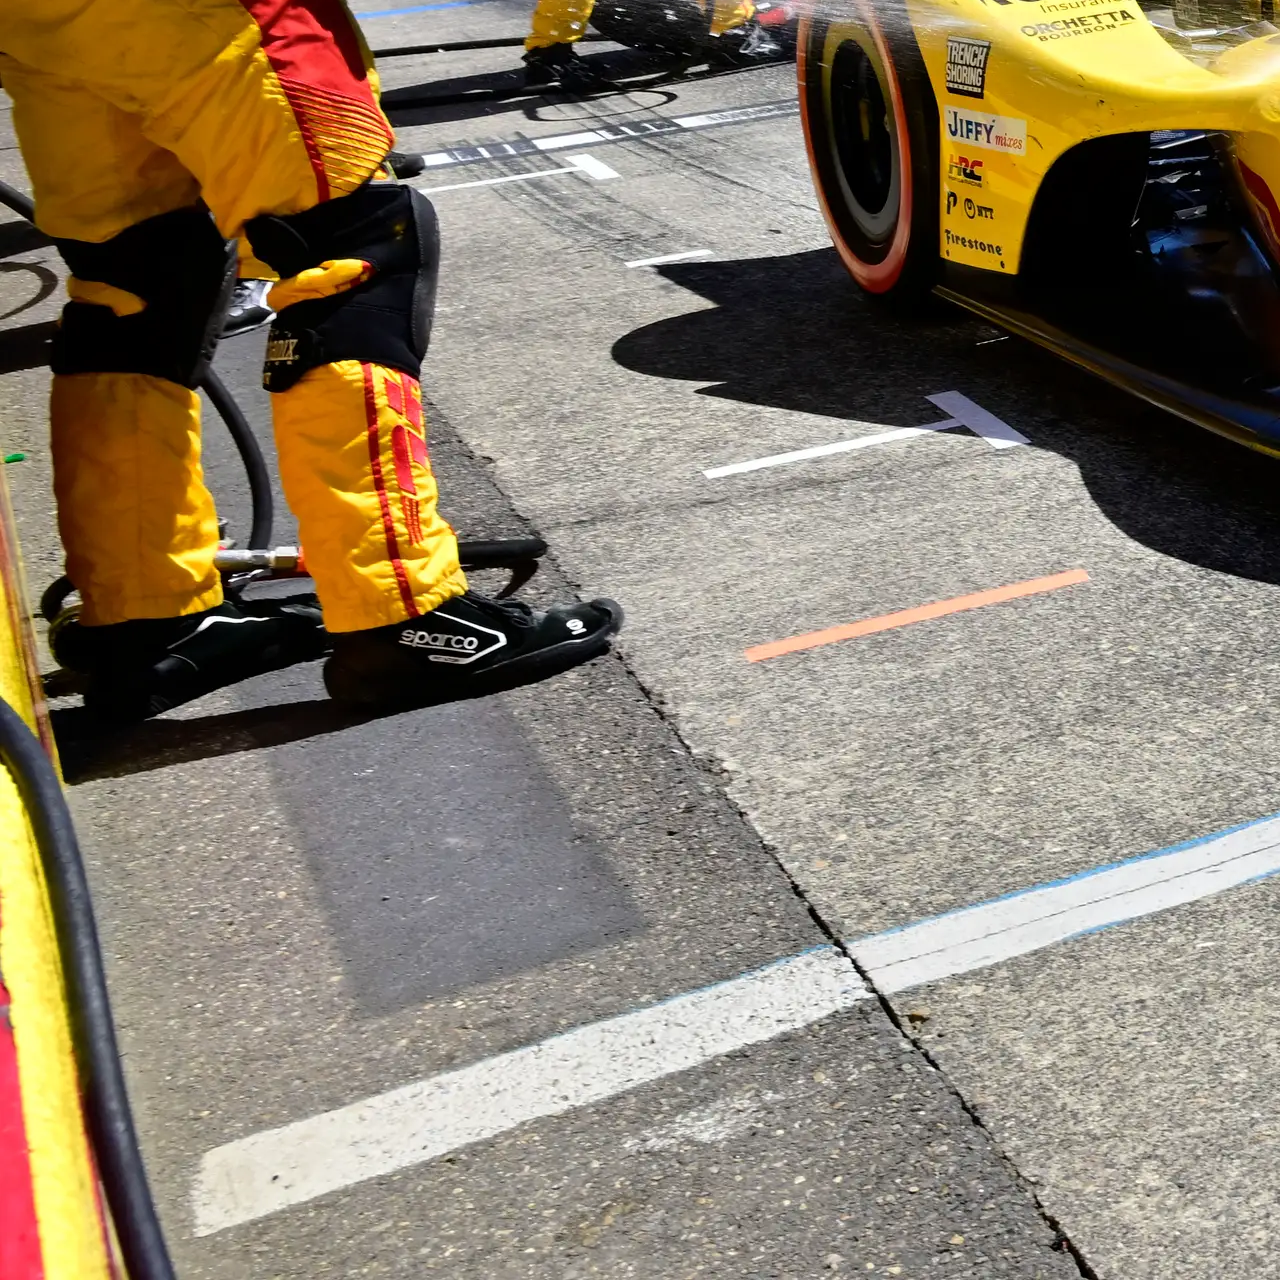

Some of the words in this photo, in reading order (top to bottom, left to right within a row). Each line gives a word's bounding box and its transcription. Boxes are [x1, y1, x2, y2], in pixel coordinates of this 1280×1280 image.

[1020, 9, 1136, 38] ORCHETTA
[1037, 23, 1118, 43] BOURBON
[946, 41, 988, 69] TRENCH
[945, 62, 984, 87] SHORING
[995, 132, 1024, 151] mixes
[948, 153, 984, 182] HRC
[976, 205, 994, 220] NTT
[944, 228, 1003, 257] Firestone
[400, 626, 480, 652] sparco
